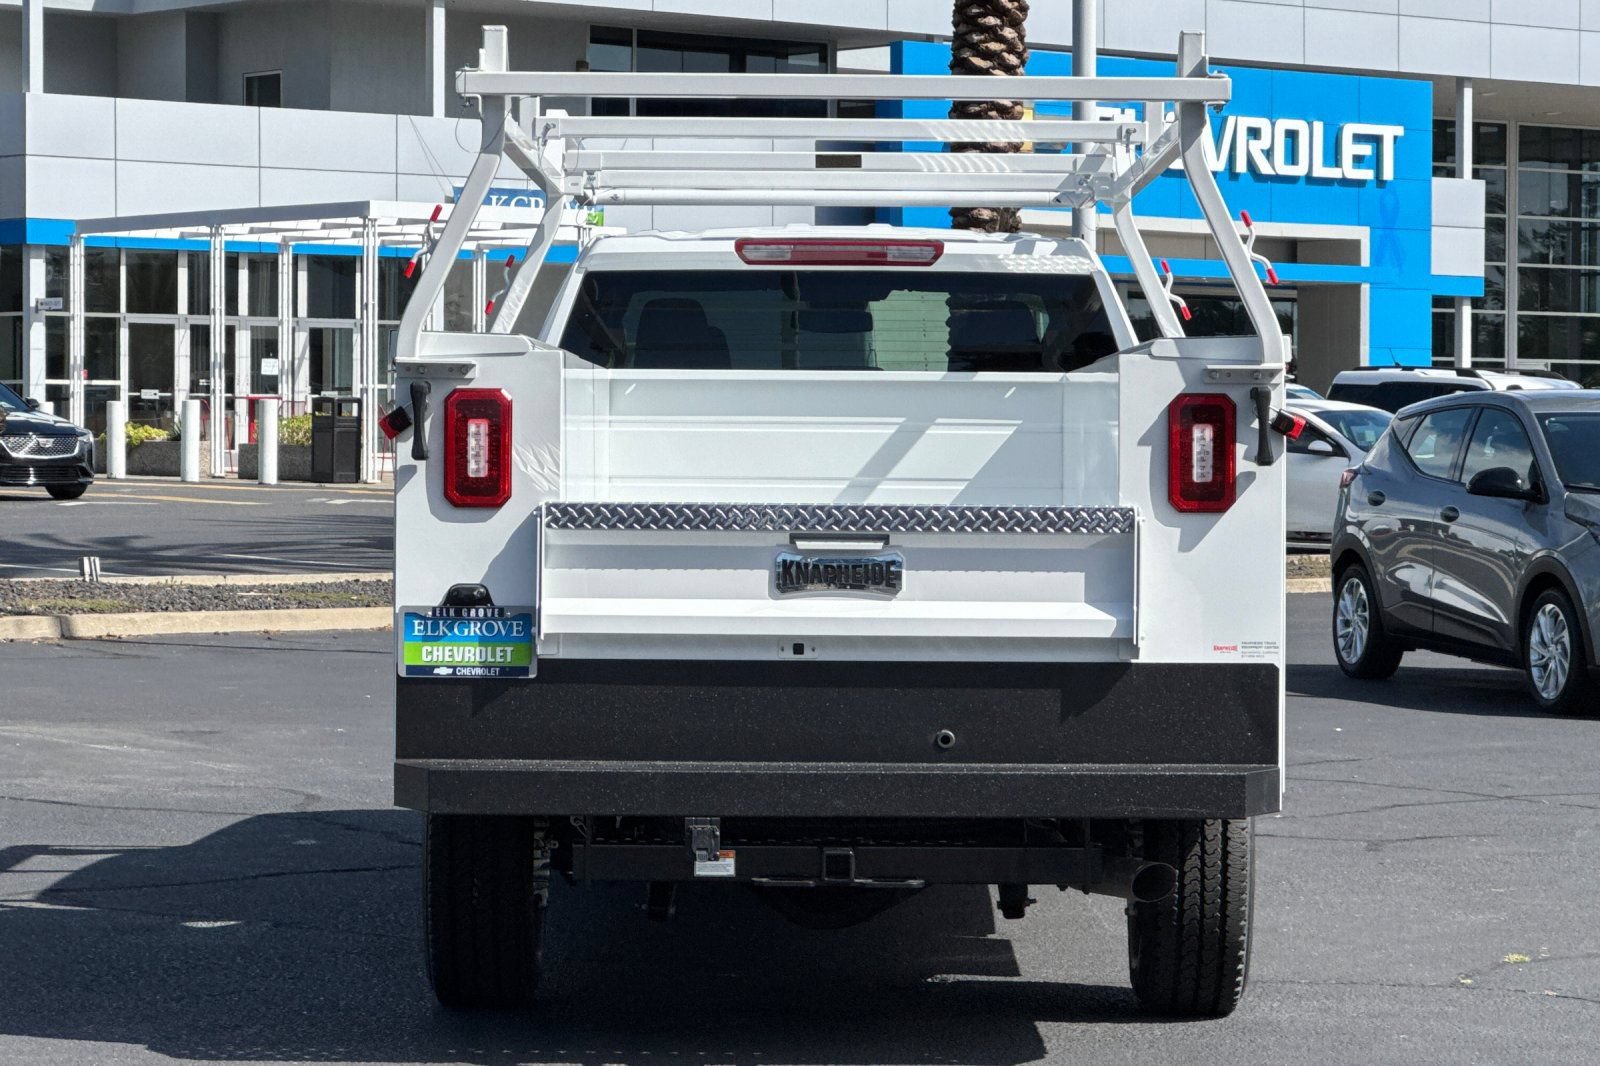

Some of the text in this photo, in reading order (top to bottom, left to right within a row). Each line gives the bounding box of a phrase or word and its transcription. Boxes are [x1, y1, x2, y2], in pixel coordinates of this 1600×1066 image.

[1095, 106, 1405, 181] VROLET
[781, 559, 897, 588] KNAPHEIDE
[435, 607, 500, 618] ELK GROVE
[421, 645, 514, 663] CHEVROLET
[455, 667, 501, 676] CHEVROLET
